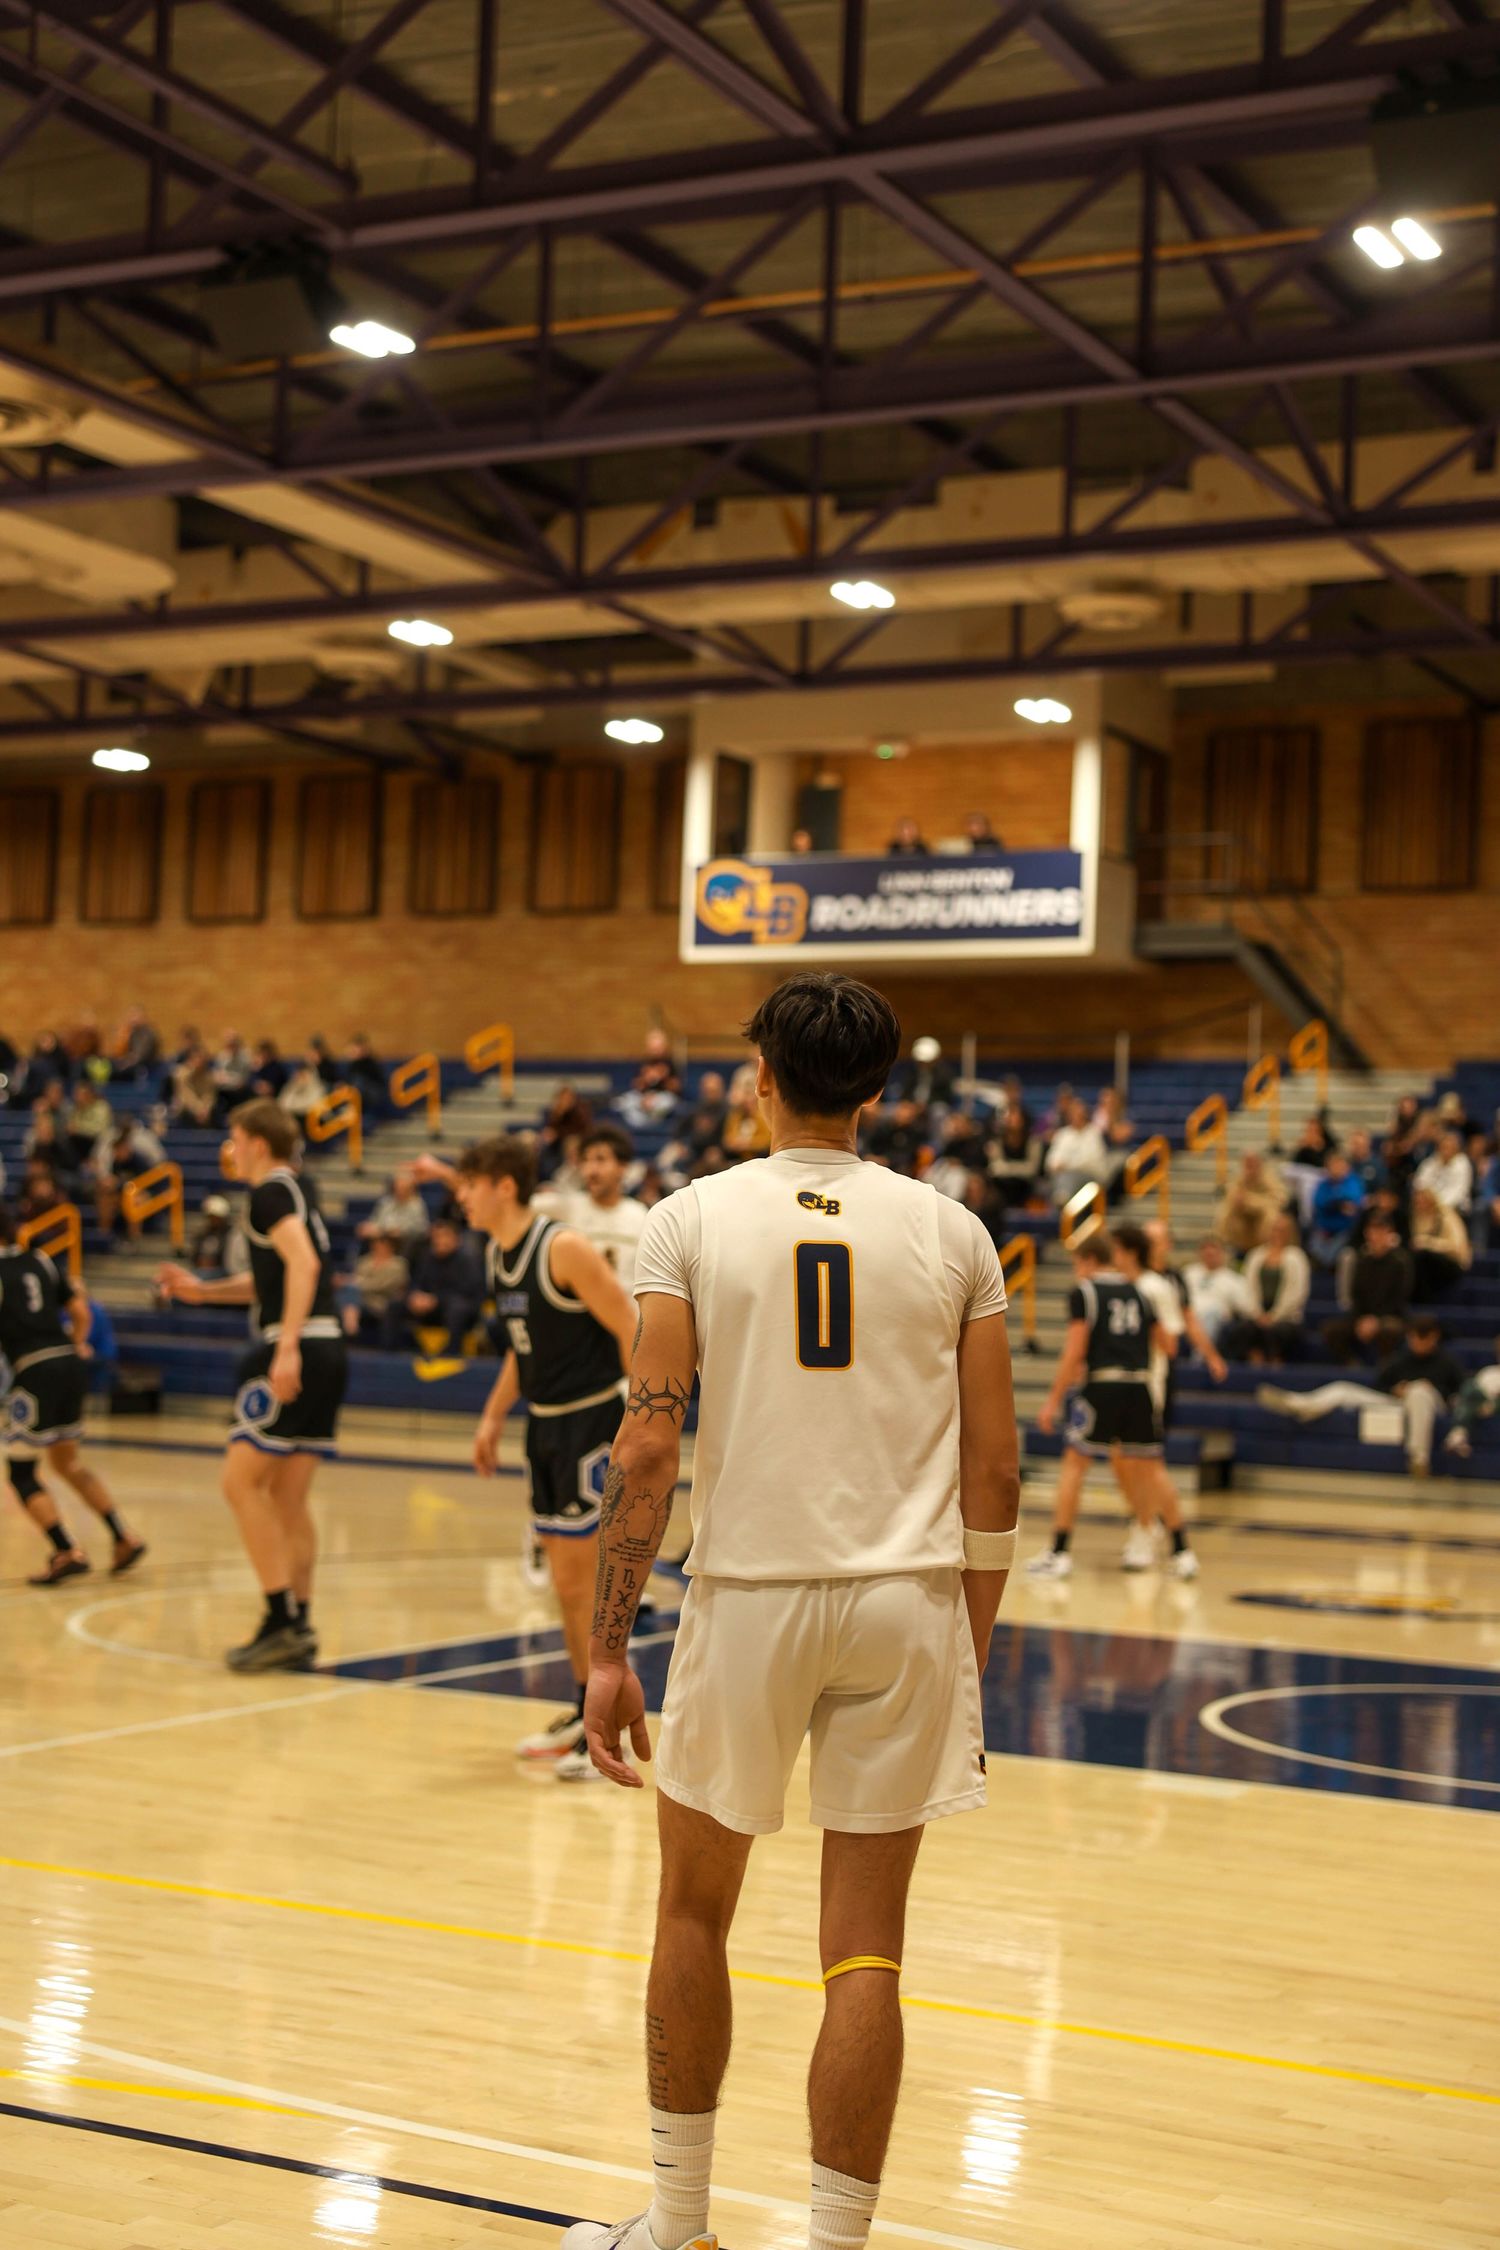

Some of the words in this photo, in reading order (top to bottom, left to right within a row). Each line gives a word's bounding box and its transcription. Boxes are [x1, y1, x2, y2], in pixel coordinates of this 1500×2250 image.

[811, 887, 1081, 931] ROADRUNNERS
[23, 1272, 43, 1313] 3
[793, 1240, 855, 1371] 0
[1107, 1298, 1140, 1335] 24
